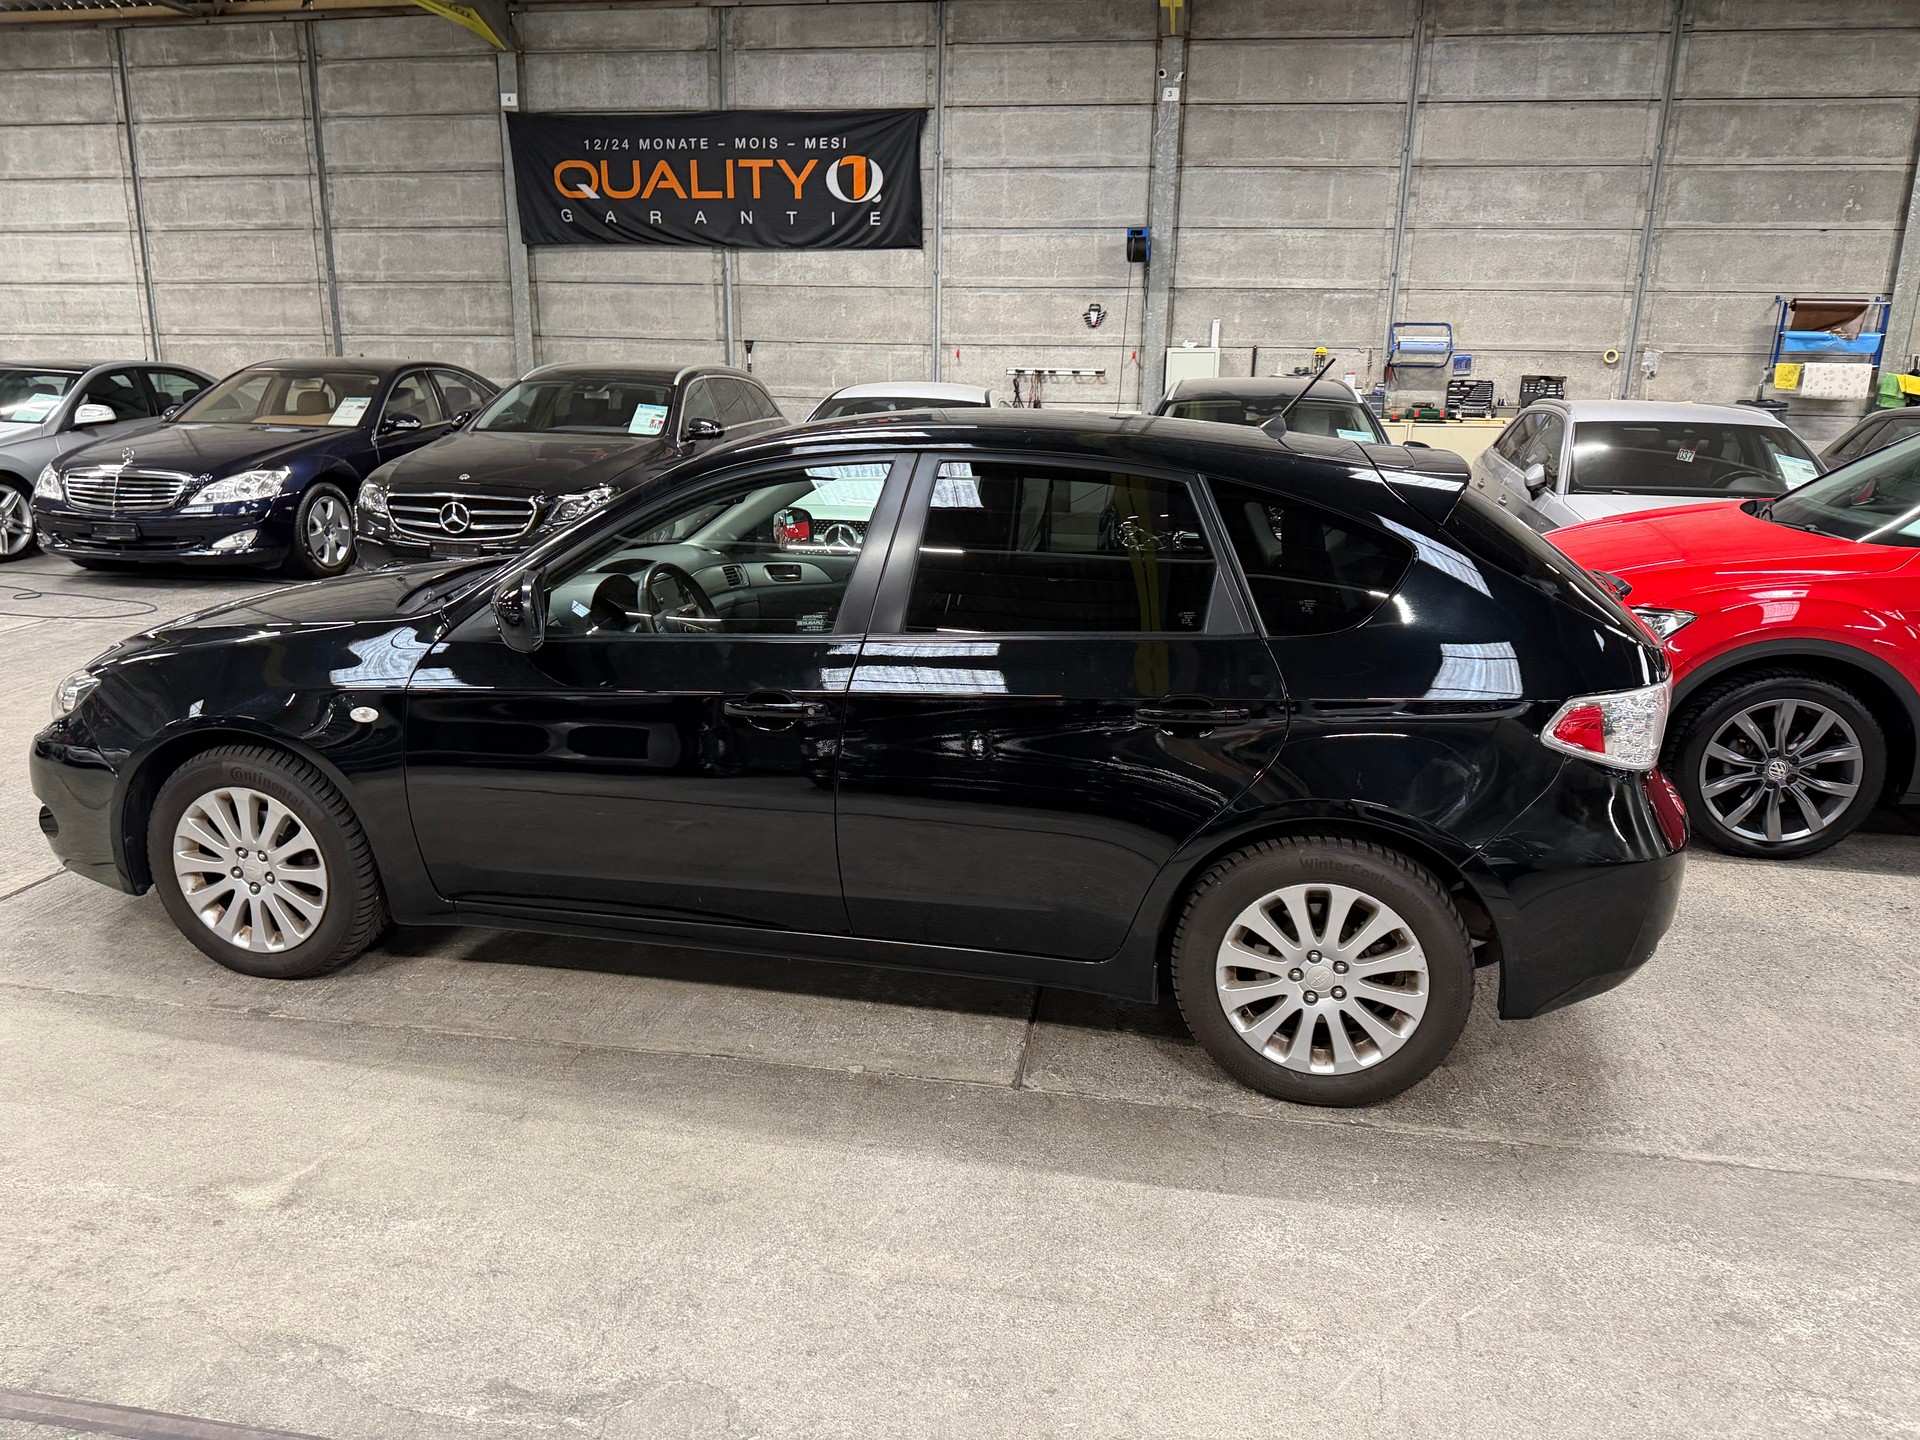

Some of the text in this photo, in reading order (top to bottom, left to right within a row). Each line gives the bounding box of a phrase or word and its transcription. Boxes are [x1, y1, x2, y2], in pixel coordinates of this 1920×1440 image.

[583, 138, 630, 150] 12/24
[639, 138, 709, 150] MONATE
[734, 137, 779, 150] MOIS
[804, 137, 847, 149] MESI
[553, 159, 819, 200] QUALITY
[560, 208, 882, 226] GARANTIE
[1679, 449, 1694, 461] 037
[230, 766, 305, 809] Continental
